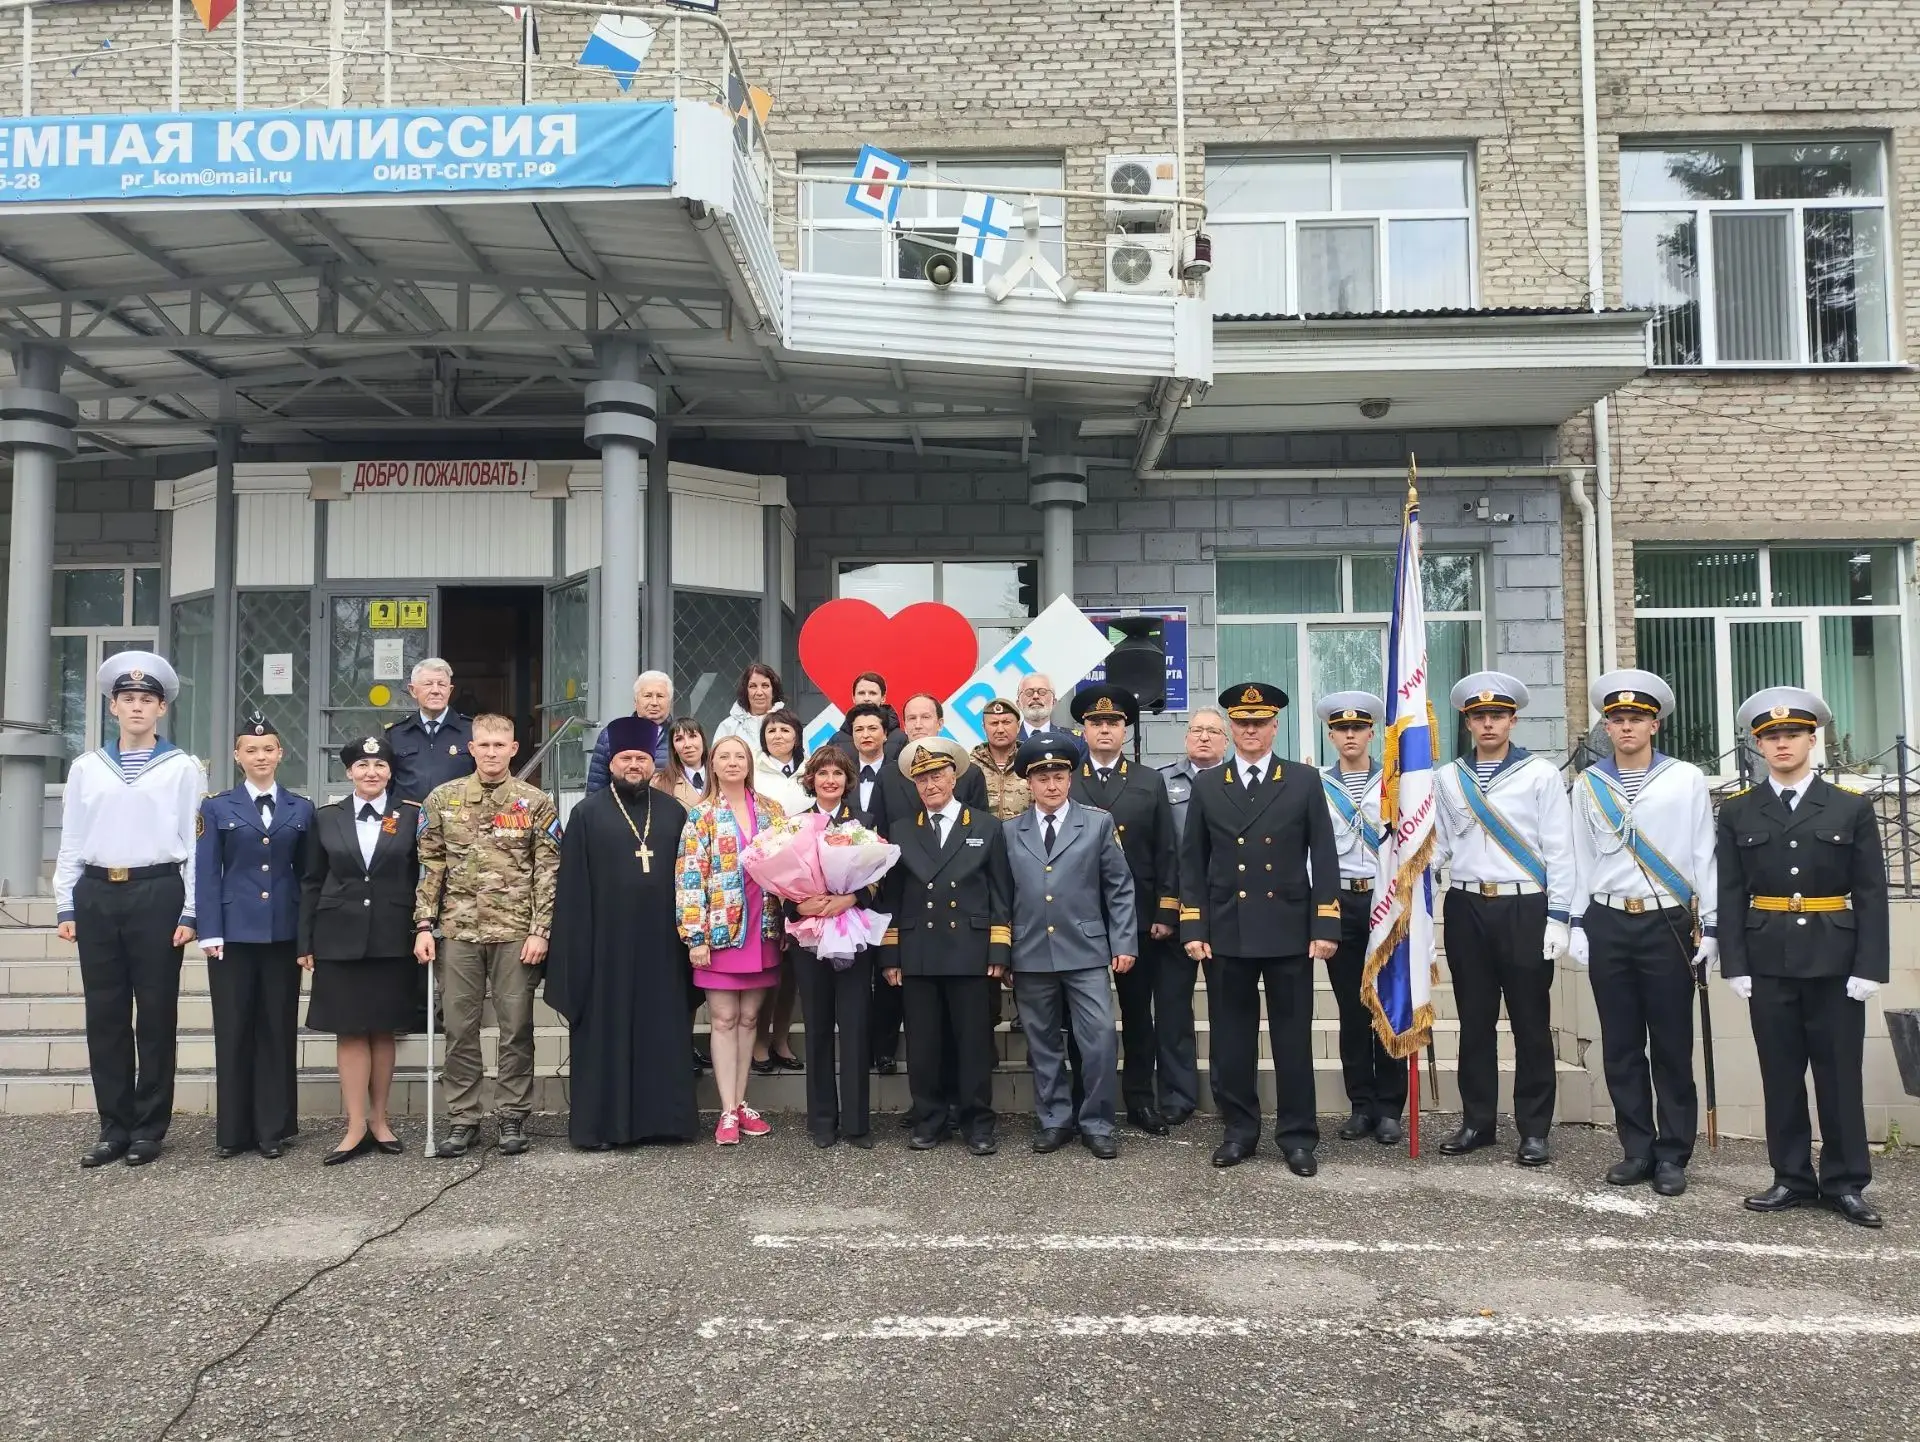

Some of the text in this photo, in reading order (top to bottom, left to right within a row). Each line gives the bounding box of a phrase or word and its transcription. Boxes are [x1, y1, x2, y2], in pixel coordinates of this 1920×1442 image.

[217, 114, 577, 162] КОМИССИЯ
[121, 168, 292, 189] pr_kom@mail.ru
[373, 162, 557, 181] ОИВТ-СГУВТ.РФ
[353, 462, 409, 491] ДОБРО
